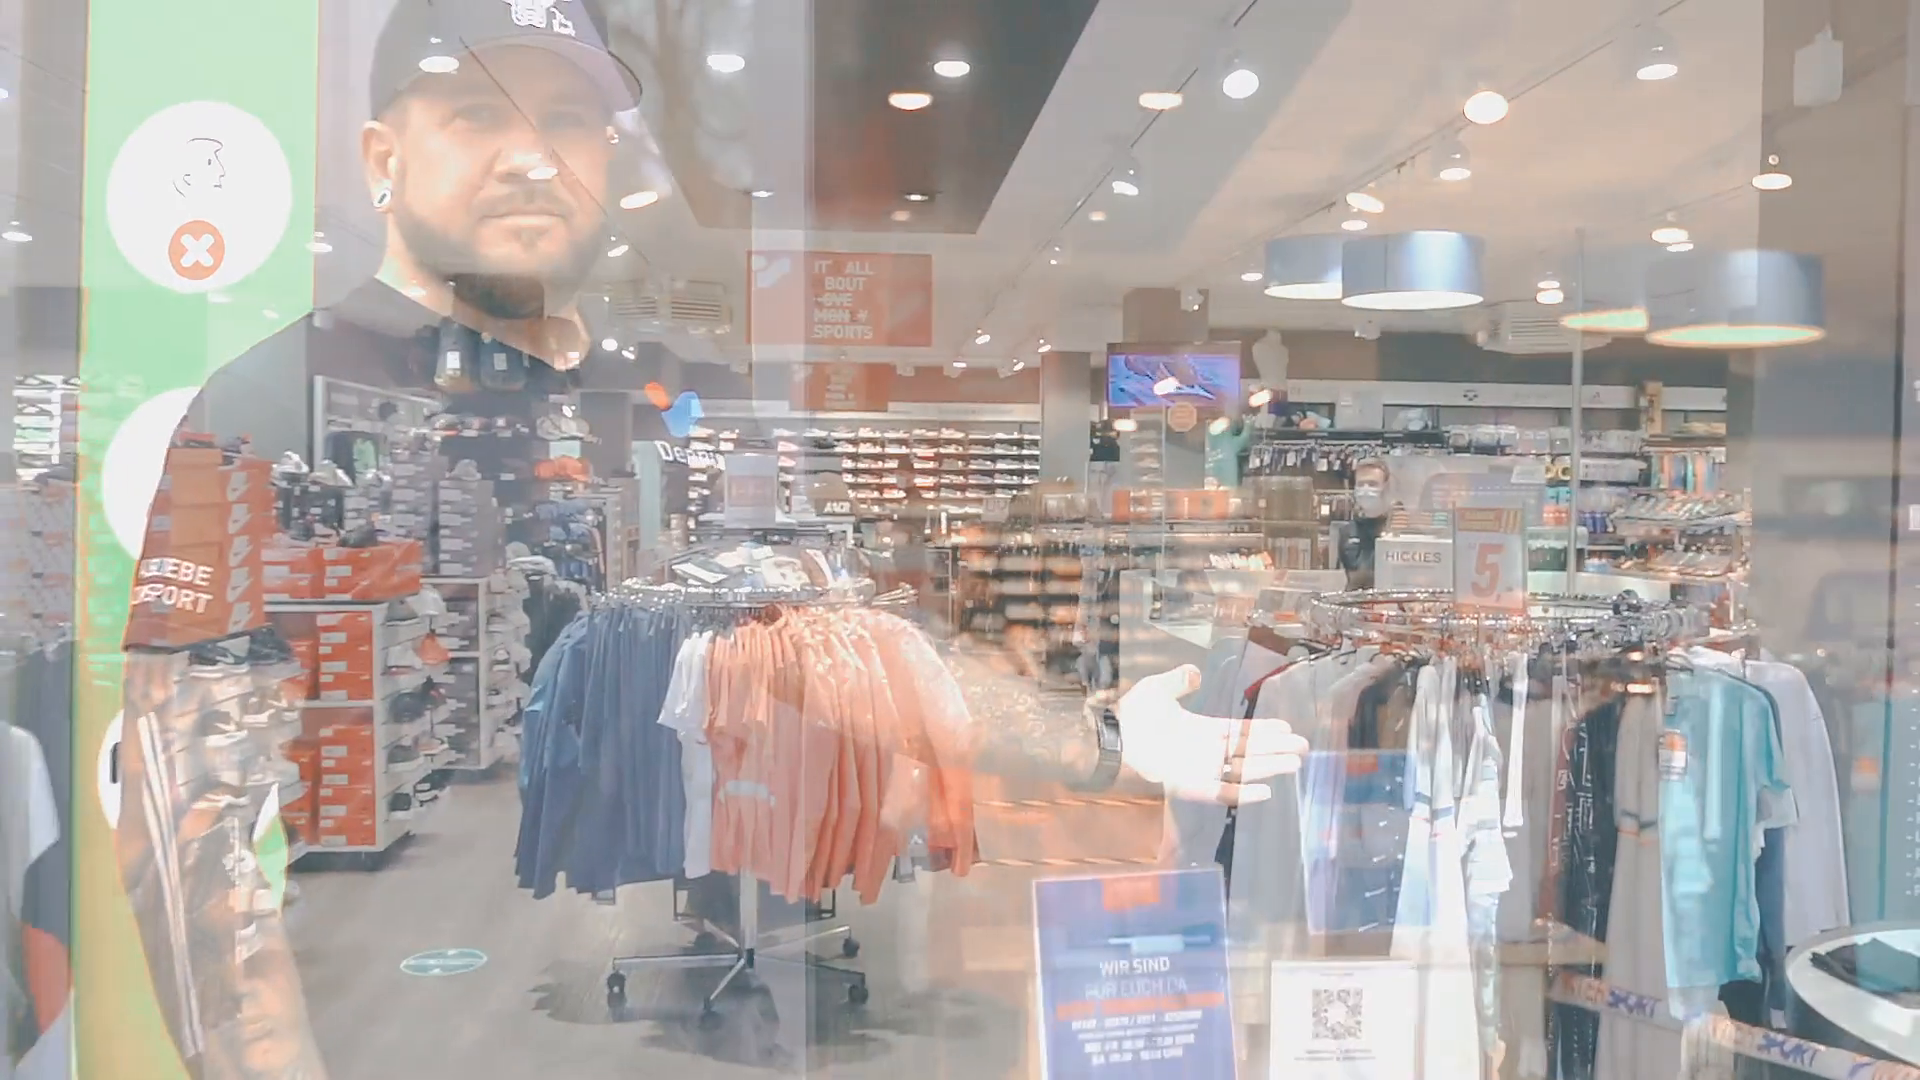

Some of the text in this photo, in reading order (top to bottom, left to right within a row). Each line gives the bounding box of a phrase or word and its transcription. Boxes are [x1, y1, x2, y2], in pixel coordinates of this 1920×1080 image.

[845, 261, 874, 276] ALL
[1100, 956, 1170, 977] WIR SIND
